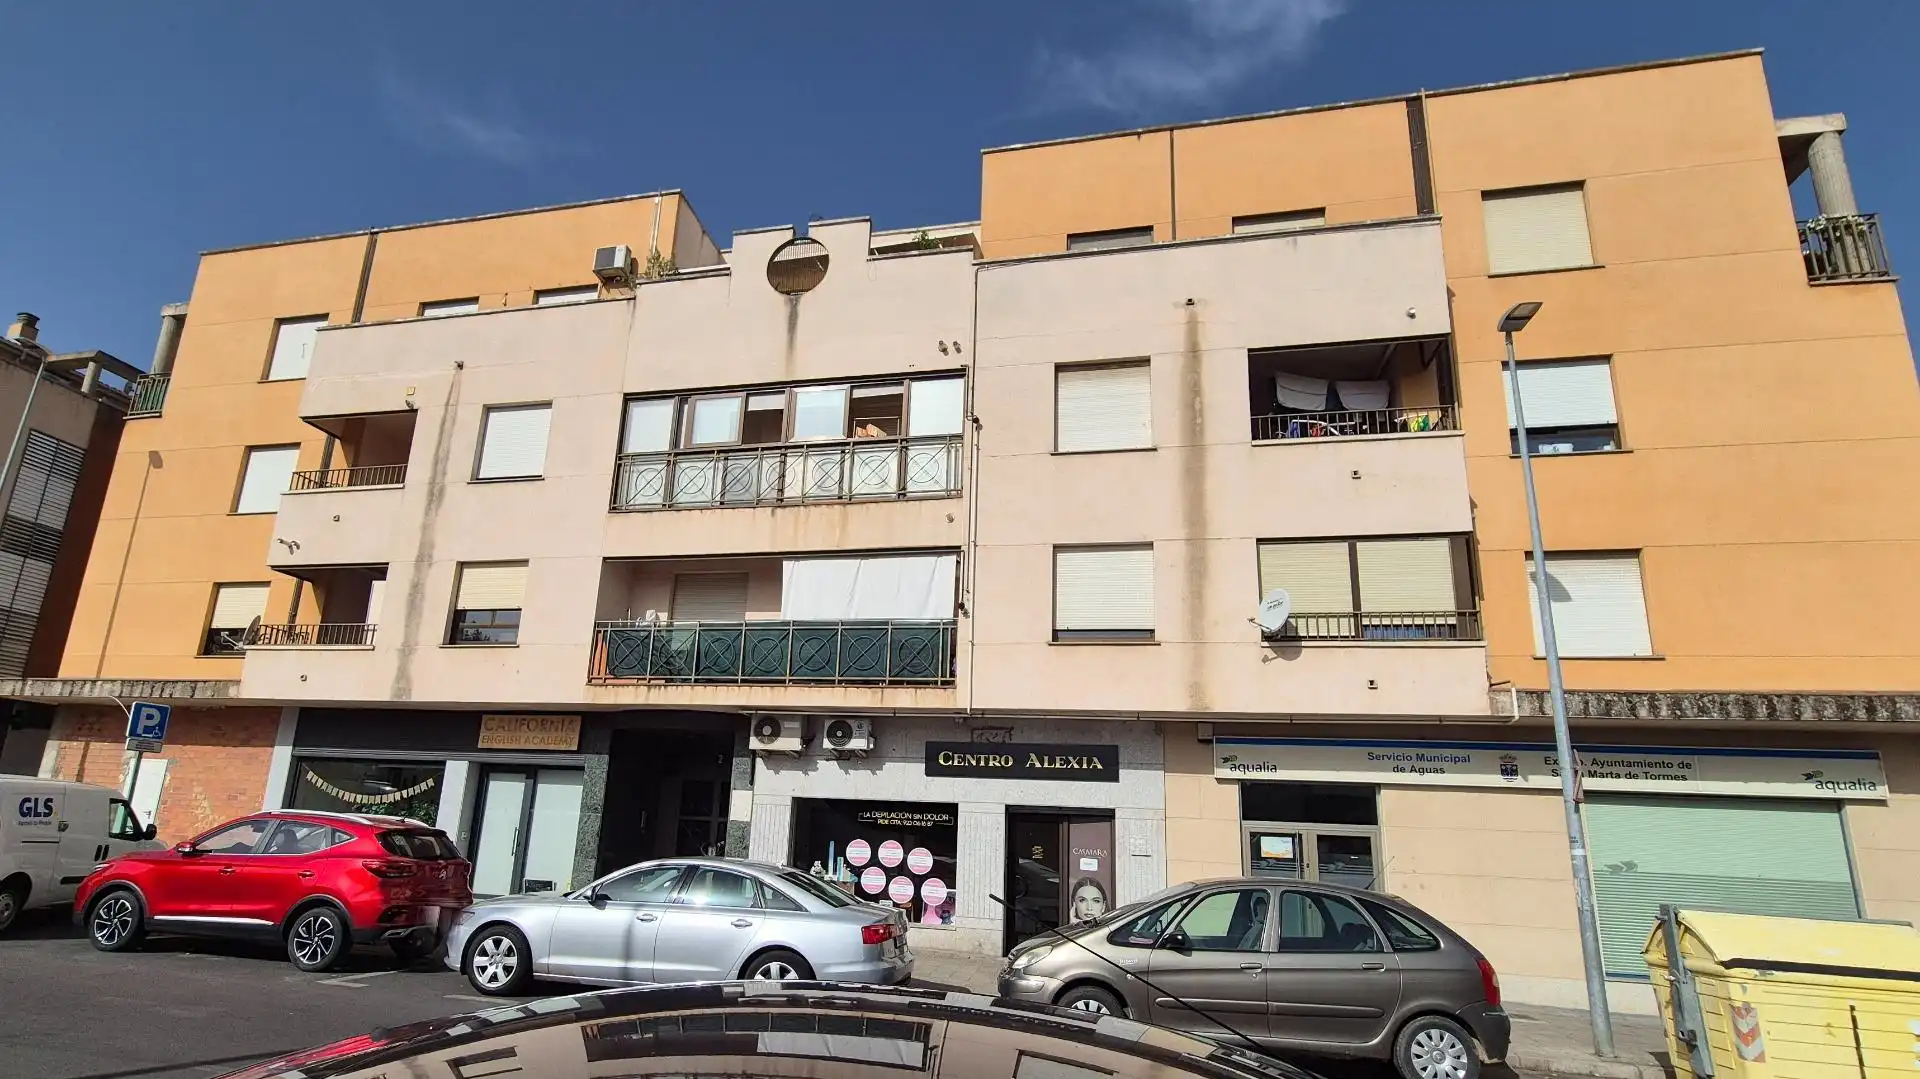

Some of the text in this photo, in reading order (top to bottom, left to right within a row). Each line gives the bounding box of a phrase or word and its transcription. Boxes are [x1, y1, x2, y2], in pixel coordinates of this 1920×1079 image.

[136, 707, 161, 735] P
[483, 716, 577, 733] CALIFORNIA
[481, 734, 575, 747] ENGLISH ACADEMY
[938, 751, 1104, 770] CENTRO ALEXIA
[1367, 751, 1471, 765] Servicio Municipal
[1590, 757, 1674, 769] Ayuntamiento
[1677, 760, 1692, 770] de
[1229, 761, 1278, 775] aqualia
[1392, 765, 1446, 776] de Aguas
[1587, 769, 1621, 779] Marta
[1624, 770, 1640, 780] de
[1642, 771, 1688, 782] Tormes
[1815, 777, 1878, 794] aqualia
[18, 797, 54, 818] GLS
[923, 813, 949, 821] DOLOR
